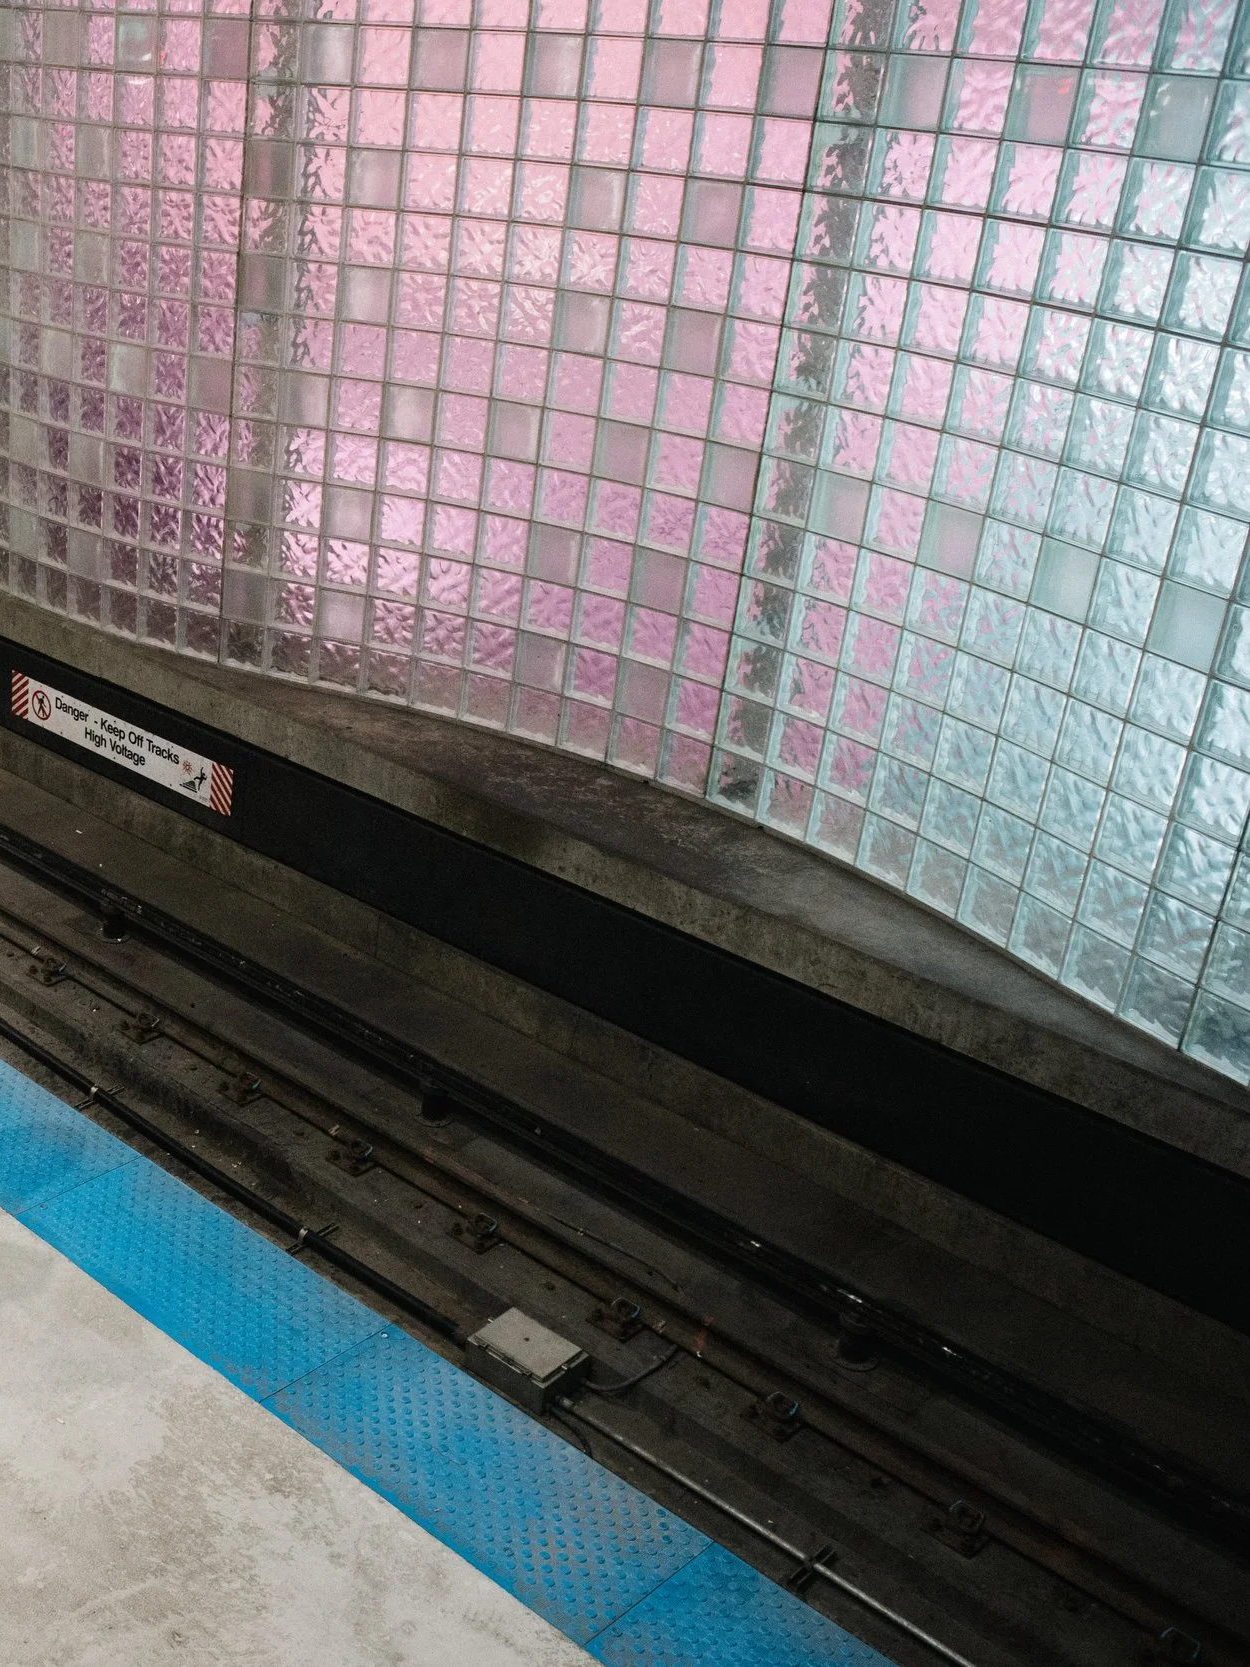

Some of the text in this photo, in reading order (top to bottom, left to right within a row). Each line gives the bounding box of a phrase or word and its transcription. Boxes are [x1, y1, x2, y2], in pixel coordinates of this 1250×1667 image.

[55, 697, 89, 723] Danger
[101, 718, 126, 741] Keep
[128, 731, 144, 748] Off
[146, 739, 180, 765] Tracks
[84, 727, 146, 766] High Voltage
